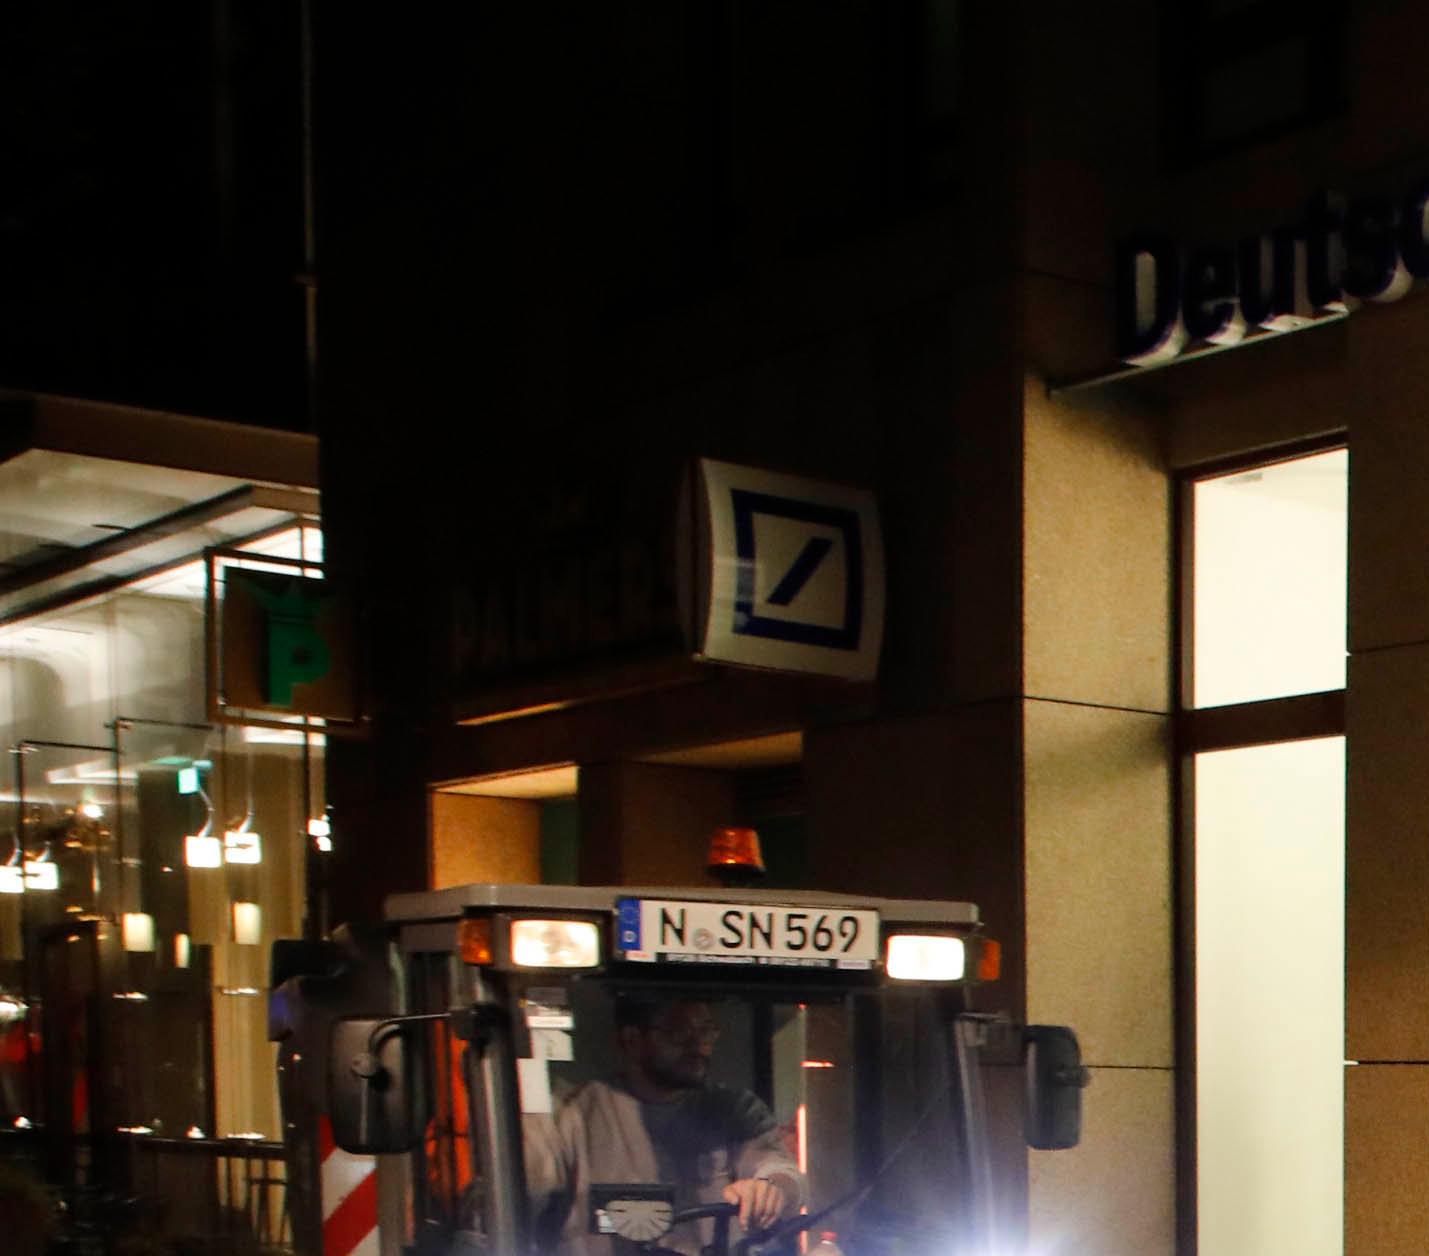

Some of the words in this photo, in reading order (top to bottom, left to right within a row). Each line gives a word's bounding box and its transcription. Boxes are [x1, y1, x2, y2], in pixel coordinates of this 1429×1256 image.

[448, 540, 668, 676] PALMER
[660, 907, 685, 947] N
[786, 913, 859, 953] 569
